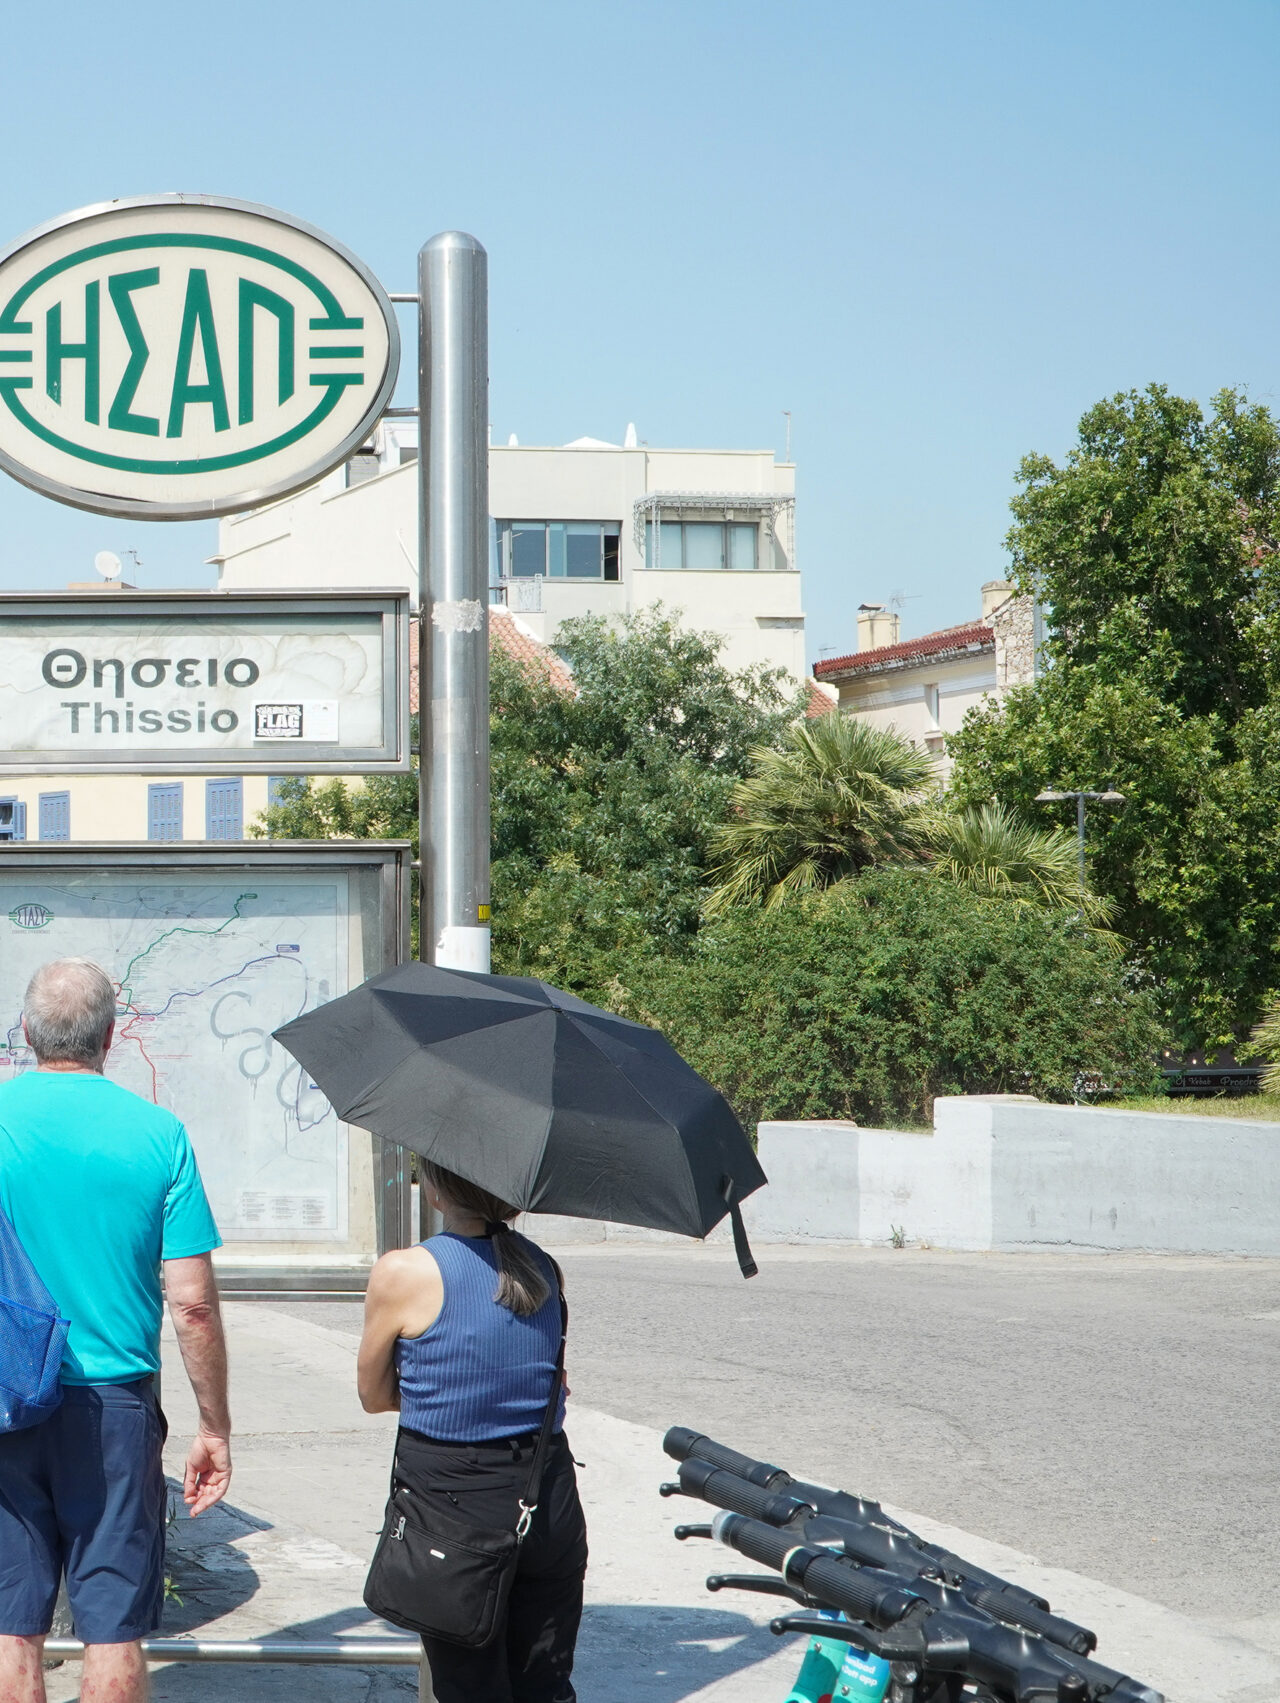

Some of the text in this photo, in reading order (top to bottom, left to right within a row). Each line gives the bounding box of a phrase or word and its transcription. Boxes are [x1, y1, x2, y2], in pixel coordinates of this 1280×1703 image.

[46, 267, 294, 439] ΗΣΑΠ
[41, 648, 260, 697] Θησειο
[61, 702, 238, 733] Thissio
[258, 714, 300, 729] FLAG
[859, 1675, 877, 1687] app
